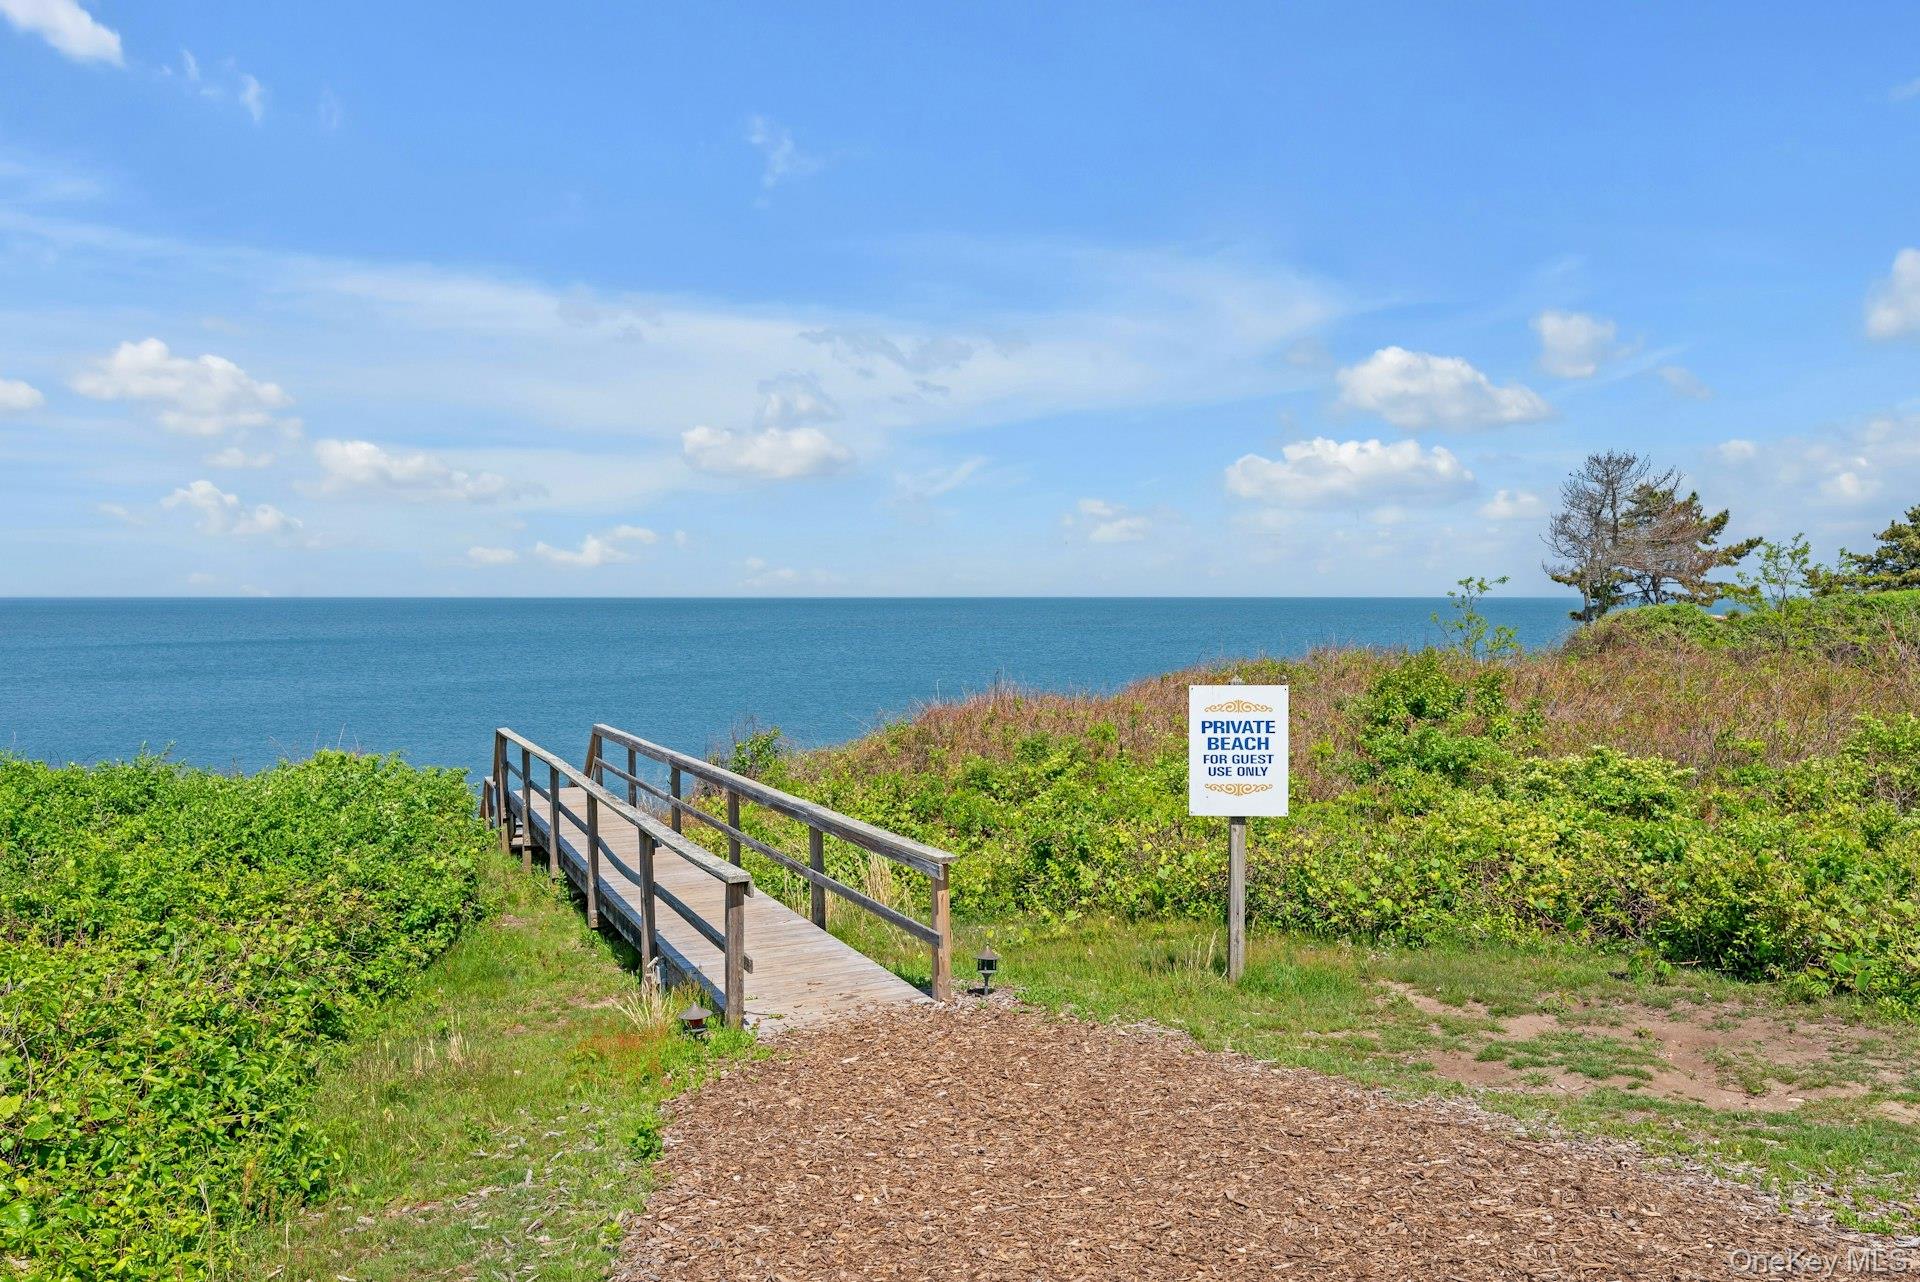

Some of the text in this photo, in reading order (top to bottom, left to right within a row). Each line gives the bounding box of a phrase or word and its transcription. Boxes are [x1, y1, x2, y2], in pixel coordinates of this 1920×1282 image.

[1201, 720, 1276, 734] PRIVATE
[1207, 737, 1270, 750] BEACH
[1203, 754, 1275, 765] FOR GUEST
[1208, 766, 1269, 777] USE ONLY
